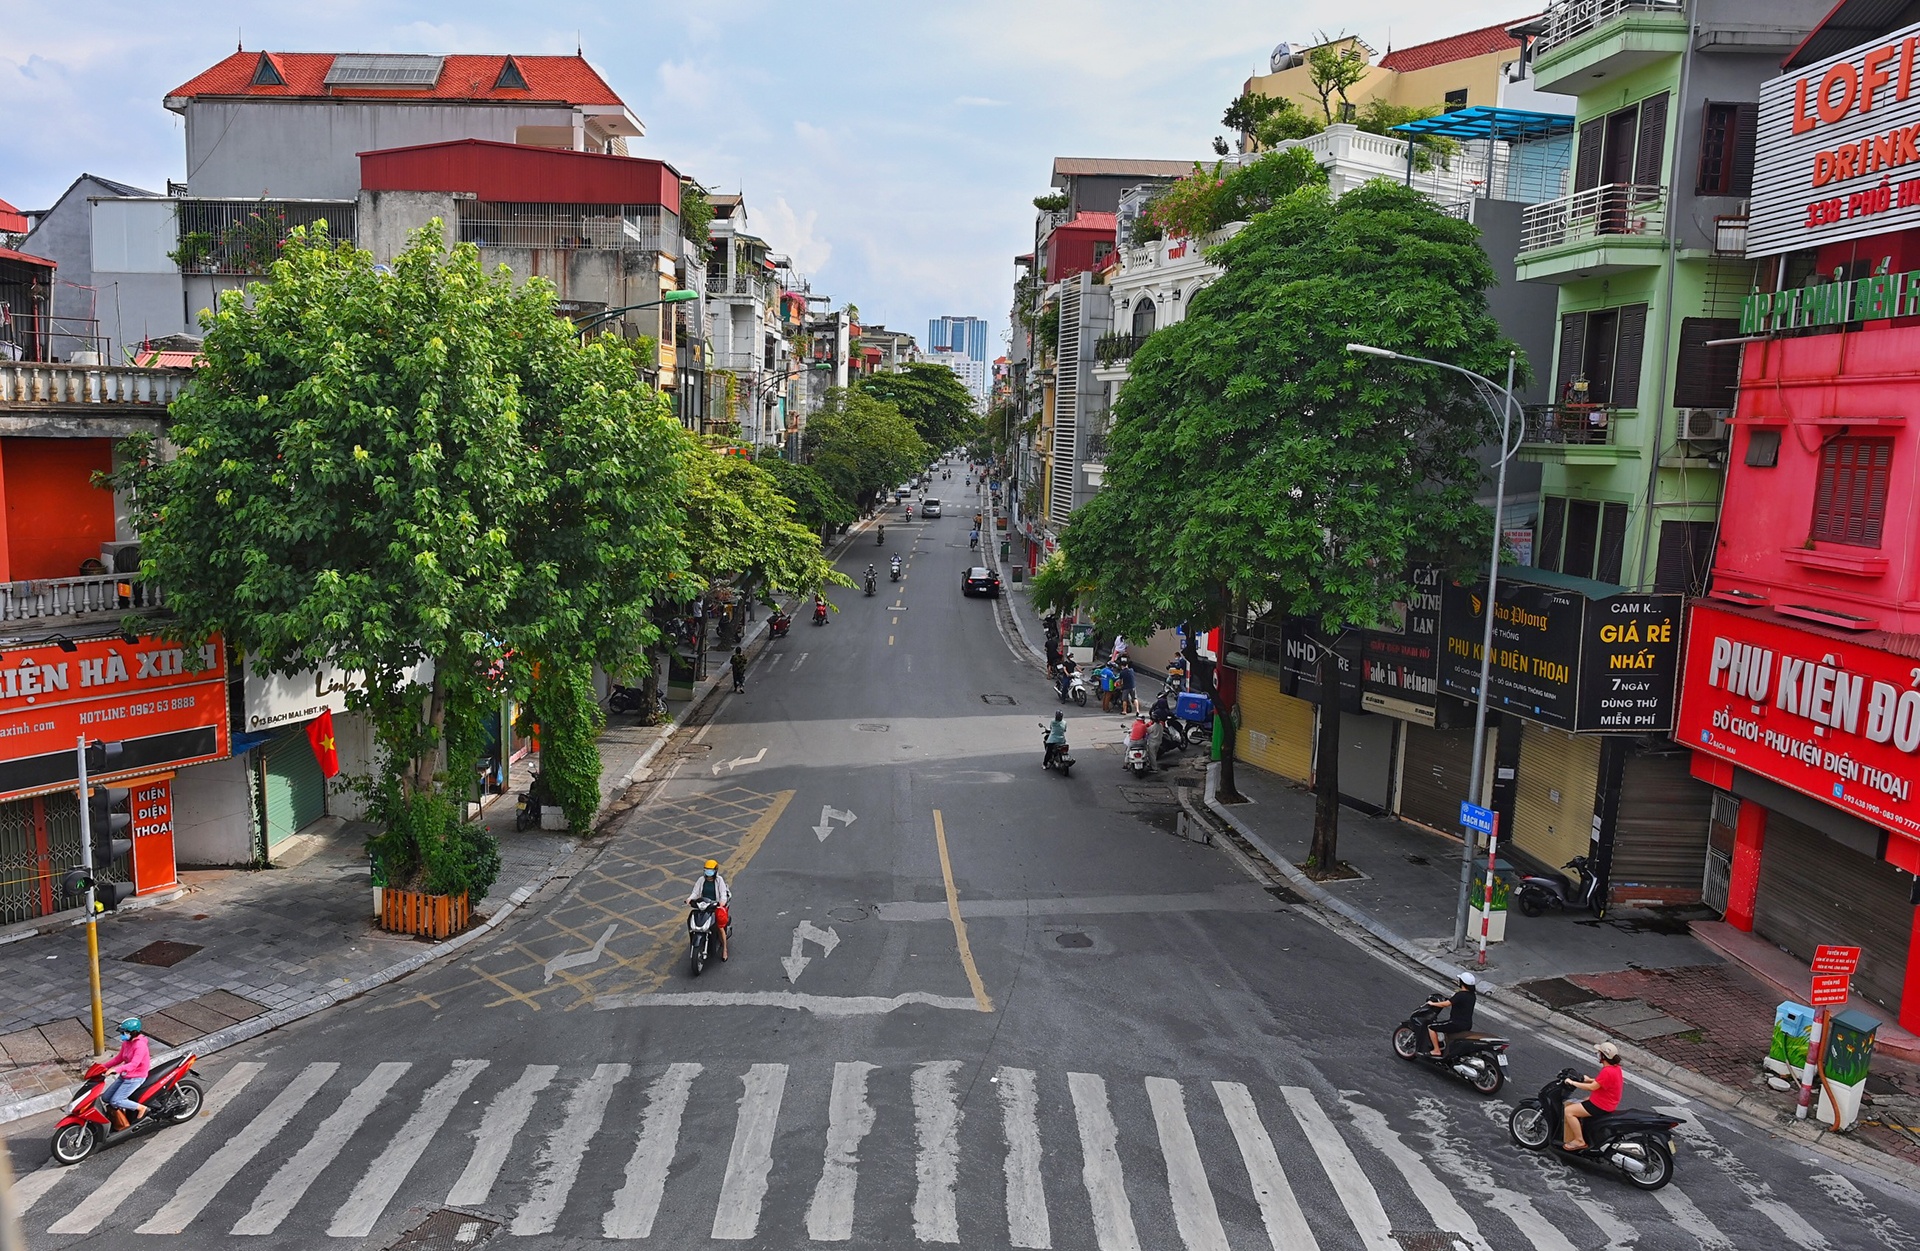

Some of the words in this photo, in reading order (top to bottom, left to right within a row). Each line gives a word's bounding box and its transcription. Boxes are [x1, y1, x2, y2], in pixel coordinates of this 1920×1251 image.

[1792, 36, 1920, 135] LOFI
[1804, 198, 1842, 228] 338
[1905, 270, 1920, 316] F
[1510, 605, 1548, 631] Phong
[1611, 603, 1639, 613] CAM
[1413, 616, 1434, 635] LAN
[1499, 629, 1519, 641] THỐNG
[1600, 620, 1639, 643] GIÁ
[1647, 618, 1671, 643] RẺ
[78, 648, 129, 688] HÀ
[1448, 637, 1469, 659] PHỤ
[1473, 643, 1498, 665] KIN
[1500, 650, 1529, 673] ĐIỆN
[1532, 657, 1569, 686] THOẠI
[1610, 648, 1655, 669] NHẤT
[1363, 658, 1385, 683] Made
[1387, 663, 1397, 687] in
[1397, 665, 1436, 695] Vietnam
[1612, 678, 1621, 691] 7
[1621, 681, 1650, 691] NGÀY
[1708, 636, 1774, 715] PHỤ
[1776, 652, 1865, 737] KIỆN
[130, 702, 155, 717] 0962
[156, 700, 169, 712] 63
[171, 696, 196, 710] 8888
[1601, 697, 1634, 708] DÙNG
[1636, 698, 1658, 708] THỬ
[267, 713, 288, 724] BẠCH
[1600, 711, 1631, 725] MIỄN
[1635, 713, 1655, 725] PHÍ
[1708, 732, 1714, 745] 2
[1726, 745, 1736, 755] MAI
[1712, 704, 1730, 730] ĐỒ
[1731, 717, 1759, 742] CHƠI
[1764, 729, 1790, 758] PHỤ
[1790, 739, 1822, 767] KIỆN
[1823, 752, 1859, 782] ĐIỆN
[1861, 765, 1910, 802] THOẠI
[138, 786, 165, 803] KIỆN
[138, 804, 167, 819] ĐIỆN
[1843, 793, 1854, 804] 093
[1904, 818, 1920, 832] 7777
[135, 821, 173, 838] THOẠI
[1479, 819, 1490, 830] MAI
